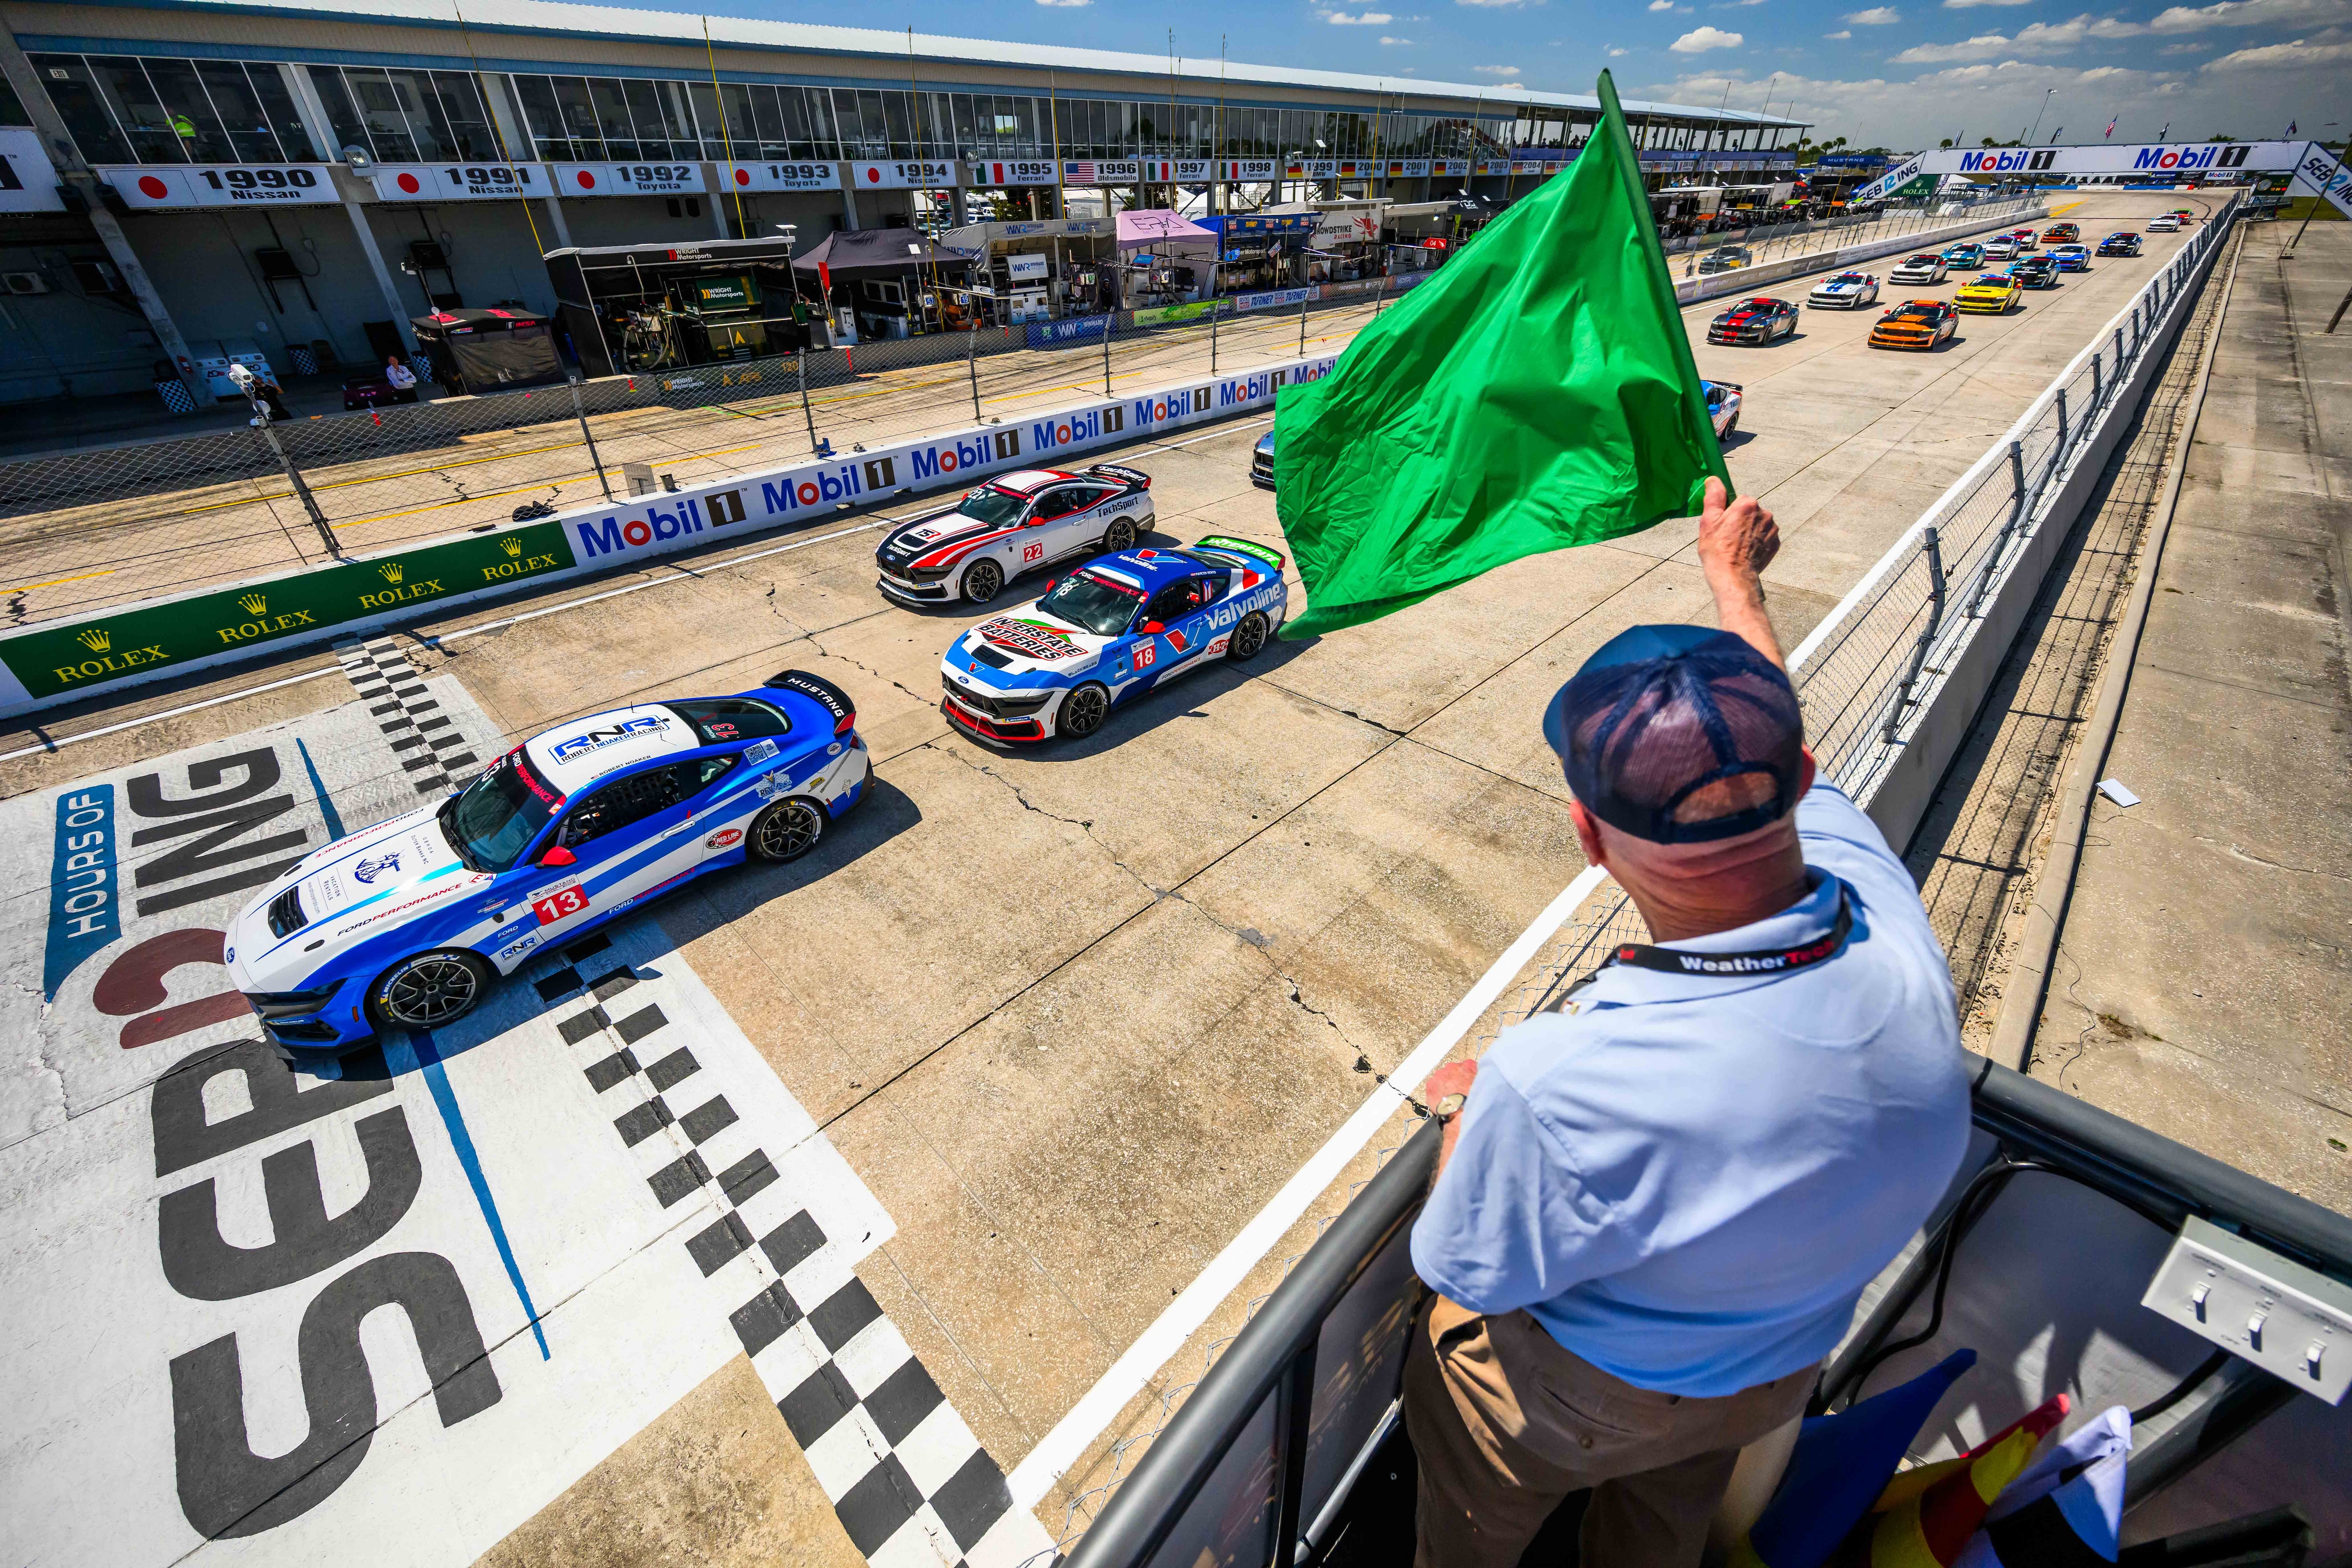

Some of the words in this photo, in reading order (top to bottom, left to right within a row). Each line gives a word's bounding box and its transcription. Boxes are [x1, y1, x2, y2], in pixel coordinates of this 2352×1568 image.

[49, 69, 69, 79] EXIT
[1241, 162, 1271, 172] 1998
[1307, 162, 1333, 172] 1999
[1358, 162, 1383, 171] 2000
[1406, 161, 1426, 171] 2001
[1448, 161, 1468, 170] 2002
[1490, 161, 1508, 169] 2003
[1523, 161, 1541, 169] 2004
[1959, 151, 2029, 171] Mobil
[2133, 146, 2218, 168] Mobil
[444, 167, 531, 185] 1991
[616, 166, 692, 182] 1992
[767, 164, 831, 179] 1993
[895, 164, 948, 177] 1994
[1008, 163, 1052, 175] 1995
[1097, 163, 1136, 175] 1996
[199, 169, 317, 190] 1990
[468, 185, 524, 194] Nissan
[635, 182, 681, 191] Toyota
[783, 179, 820, 188] Toyota
[230, 189, 301, 200] Nissan
[1250, 294, 1273, 306] TURNER
[1285, 290, 1307, 301] TURNER
[780, 360, 799, 373] 120
[672, 381, 705, 390] Motorsports
[1220, 374, 1268, 406] Mobil
[1135, 390, 1190, 427] Mobil
[1034, 411, 1099, 450] Mobil
[912, 435, 991, 479] Mobil
[1098, 465, 1147, 482] TechSport
[761, 464, 860, 514] Mobil
[968, 489, 984, 500] 22
[1097, 496, 1139, 518] TechSport
[577, 499, 703, 557] Mobil
[886, 544, 911, 557] TechSport
[1025, 544, 1042, 562] 22
[1206, 538, 1279, 562] INTERSTATE
[481, 553, 557, 581] ROLEX
[1118, 554, 1159, 571] Valvoline
[358, 579, 445, 609] ROLEX
[1056, 581, 1073, 597] 18
[1078, 571, 1140, 597] FORDPERFORMANCE
[1204, 583, 1281, 630] Valvoline
[216, 609, 317, 643] ROLEX
[978, 623, 1061, 659] BATTERIES
[990, 617, 1083, 656] INTERSTATE
[53, 645, 170, 683] ROLEX
[1136, 648, 1153, 668] 18
[1068, 661, 1097, 677] BLACKBEARD
[1162, 657, 1201, 680] FORDPERFORMANCE
[787, 677, 845, 717] MUSTANG
[554, 717, 660, 757] RNR
[702, 725, 716, 739] NOAKER
[711, 723, 739, 739] 13
[561, 746, 597, 763] ROBERT
[596, 734, 631, 748] NOAKER
[629, 725, 665, 737] RACING
[481, 761, 501, 782] 13
[599, 764, 625, 776] ROBERT
[624, 755, 652, 766] NOAKER
[512, 751, 556, 803] FORDPERFORMANCE
[65, 793, 103, 828] OF
[799, 802, 818, 815] MICHELIN
[315, 808, 424, 860] FORDPERFORMANCE
[728, 831, 740, 839] LINE
[416, 845, 425, 860] BANKS
[422, 856, 429, 865] NC
[64, 830, 107, 939] HOURS
[323, 880, 334, 901] RENTALS
[330, 875, 341, 897] VACATION
[544, 877, 576, 892] MUSTANG
[546, 880, 577, 896] CHALLENGE
[609, 867, 696, 914] FORDPERFORMANCE
[337, 883, 463, 937] FORDPERFORMANCE
[541, 891, 581, 919] 13
[498, 925, 519, 938] FORD
[501, 936, 537, 959] RNR
[1679, 940, 1835, 972] WeatherTech
[382, 965, 410, 993] MICHELIN
